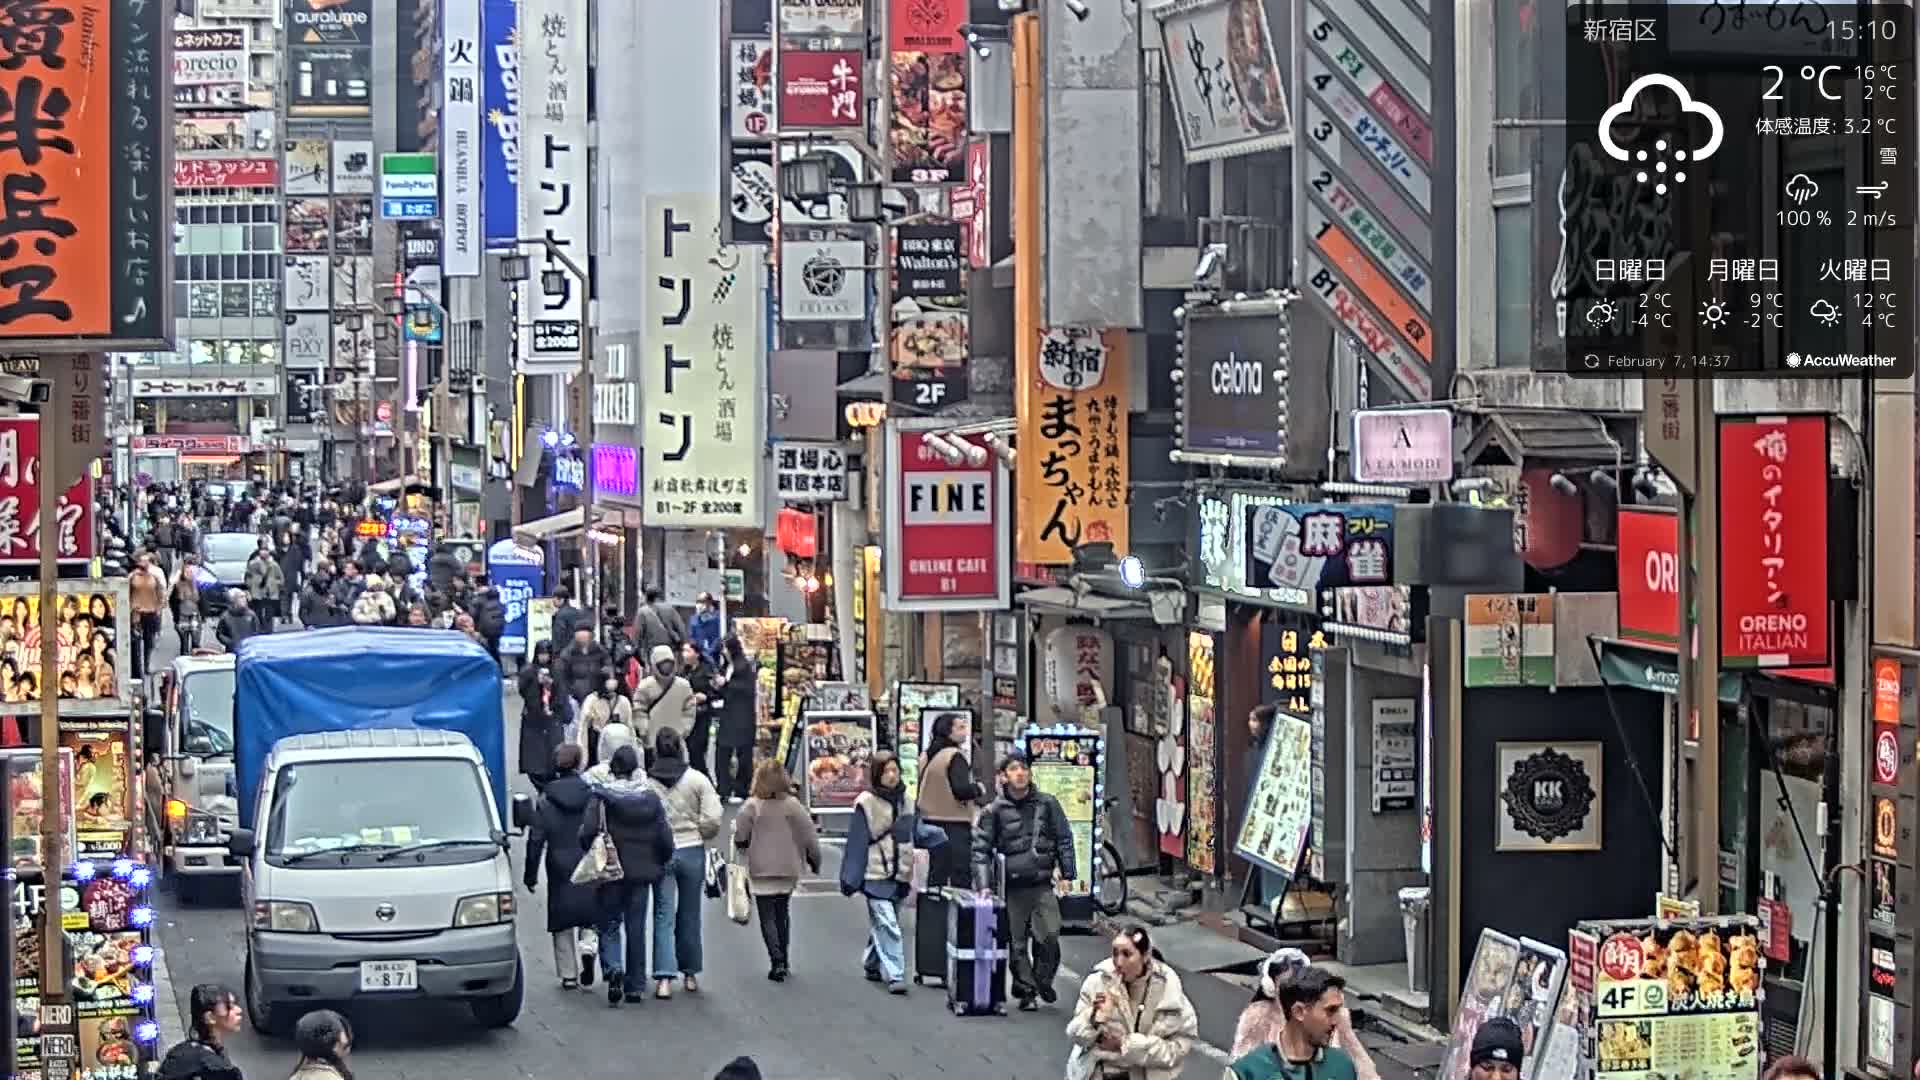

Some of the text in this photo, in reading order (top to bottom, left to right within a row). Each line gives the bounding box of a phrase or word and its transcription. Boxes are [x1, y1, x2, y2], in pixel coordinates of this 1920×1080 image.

[1313, 20, 1334, 42] 5
[449, 37, 473, 103] 火鍋
[829, 58, 858, 120] 牛門
[1313, 74, 1332, 91] 4
[1354, 115, 1412, 178] センチュリー
[1313, 121, 1333, 142] 3
[384, 179, 434, 192] FamilyMart
[910, 168, 949, 183] 3F
[1312, 171, 1333, 192] 2
[456, 203, 468, 253] HOTPOT
[900, 254, 958, 270] Walton's
[1310, 267, 1340, 298] B1
[659, 207, 692, 462] トントン
[711, 322, 737, 442] 焼とん酒場
[915, 383, 946, 404] 2F
[778, 449, 843, 470] 酒場心
[1040, 394, 1084, 548] まっちゃん
[777, 474, 843, 492] 新宿本店
[910, 483, 985, 512] FINE
[1347, 517, 1389, 535] フリー
[1753, 429, 1788, 604] 俺のイタリアン
[1303, 512, 1387, 581] 麻雀
[909, 558, 988, 574] ONLINE CAFE
[1645, 550, 1679, 592] OR
[940, 577, 957, 592] B1
[1739, 613, 1807, 632] ORENO
[1739, 635, 1808, 650] ITALIAN
[1534, 780, 1563, 799] KK
[1601, 986, 1636, 1010] 4F
[40, 1005, 72, 1026] NERO
[42, 1036, 74, 1056] NERO
